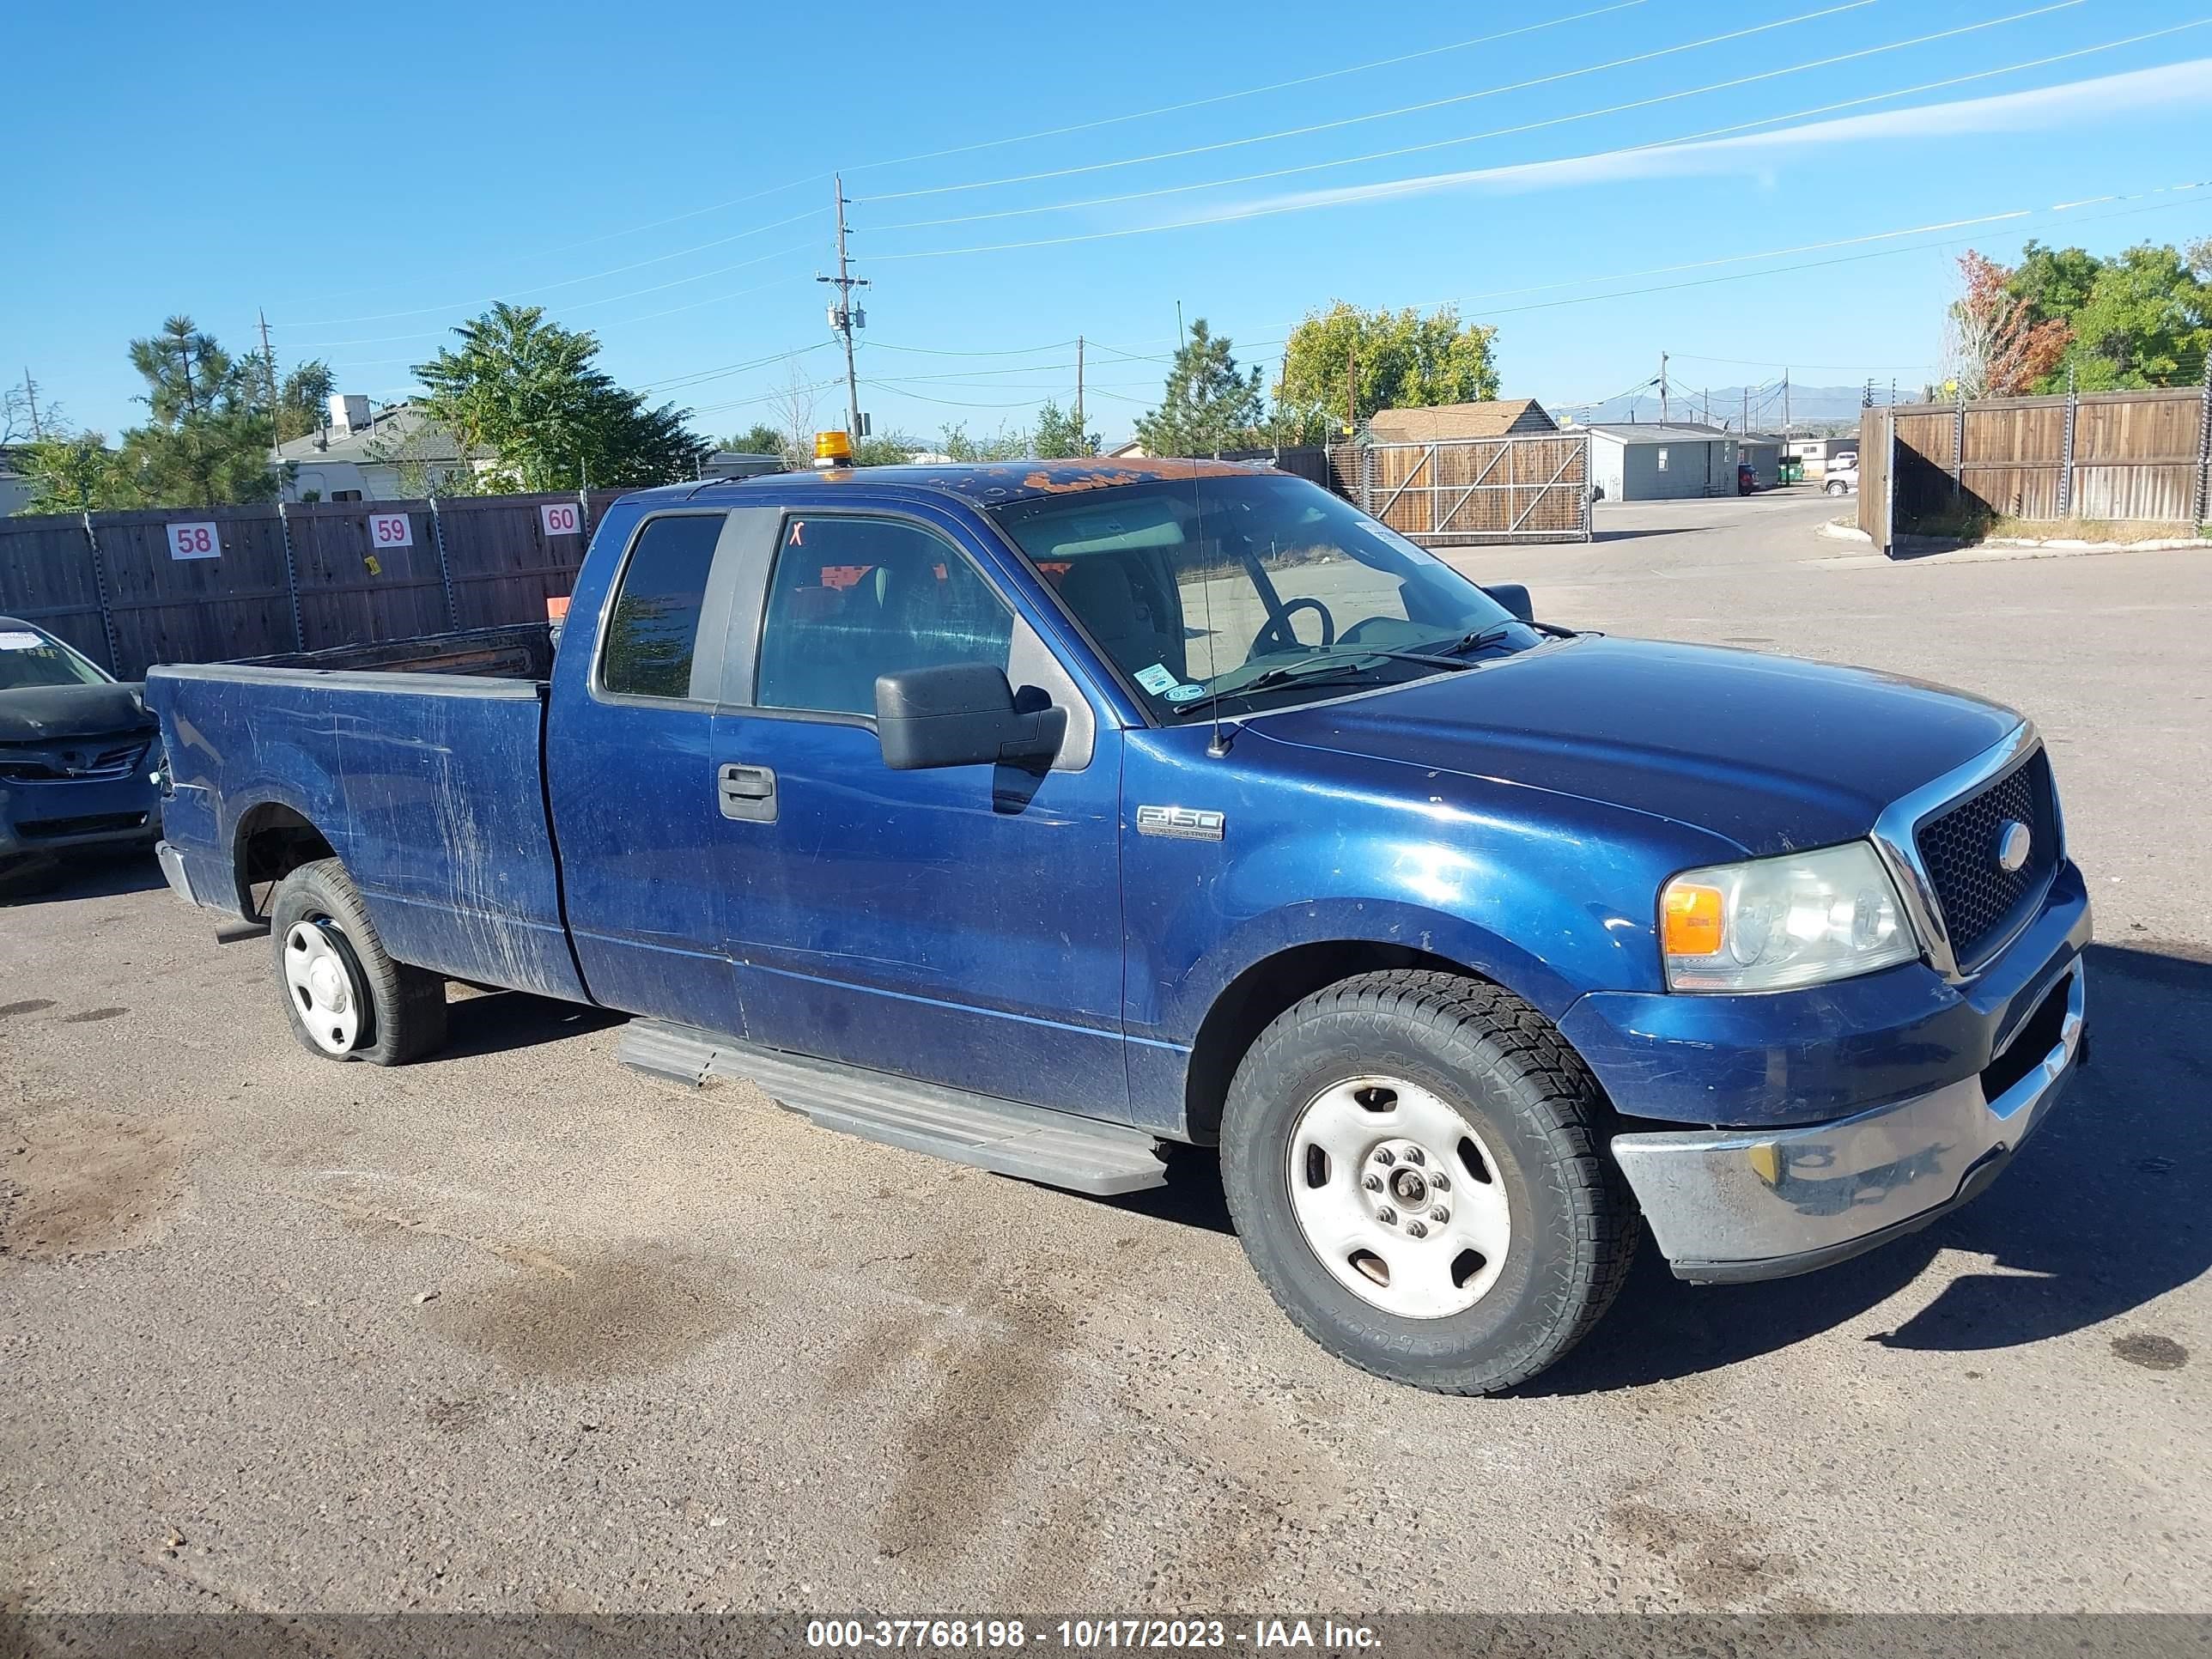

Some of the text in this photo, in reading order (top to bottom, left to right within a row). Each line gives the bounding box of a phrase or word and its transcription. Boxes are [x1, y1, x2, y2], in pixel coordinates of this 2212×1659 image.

[549, 508, 574, 530] 60
[178, 528, 211, 554] 58
[378, 520, 404, 542] 59
[1139, 807, 1221, 830] F-150
